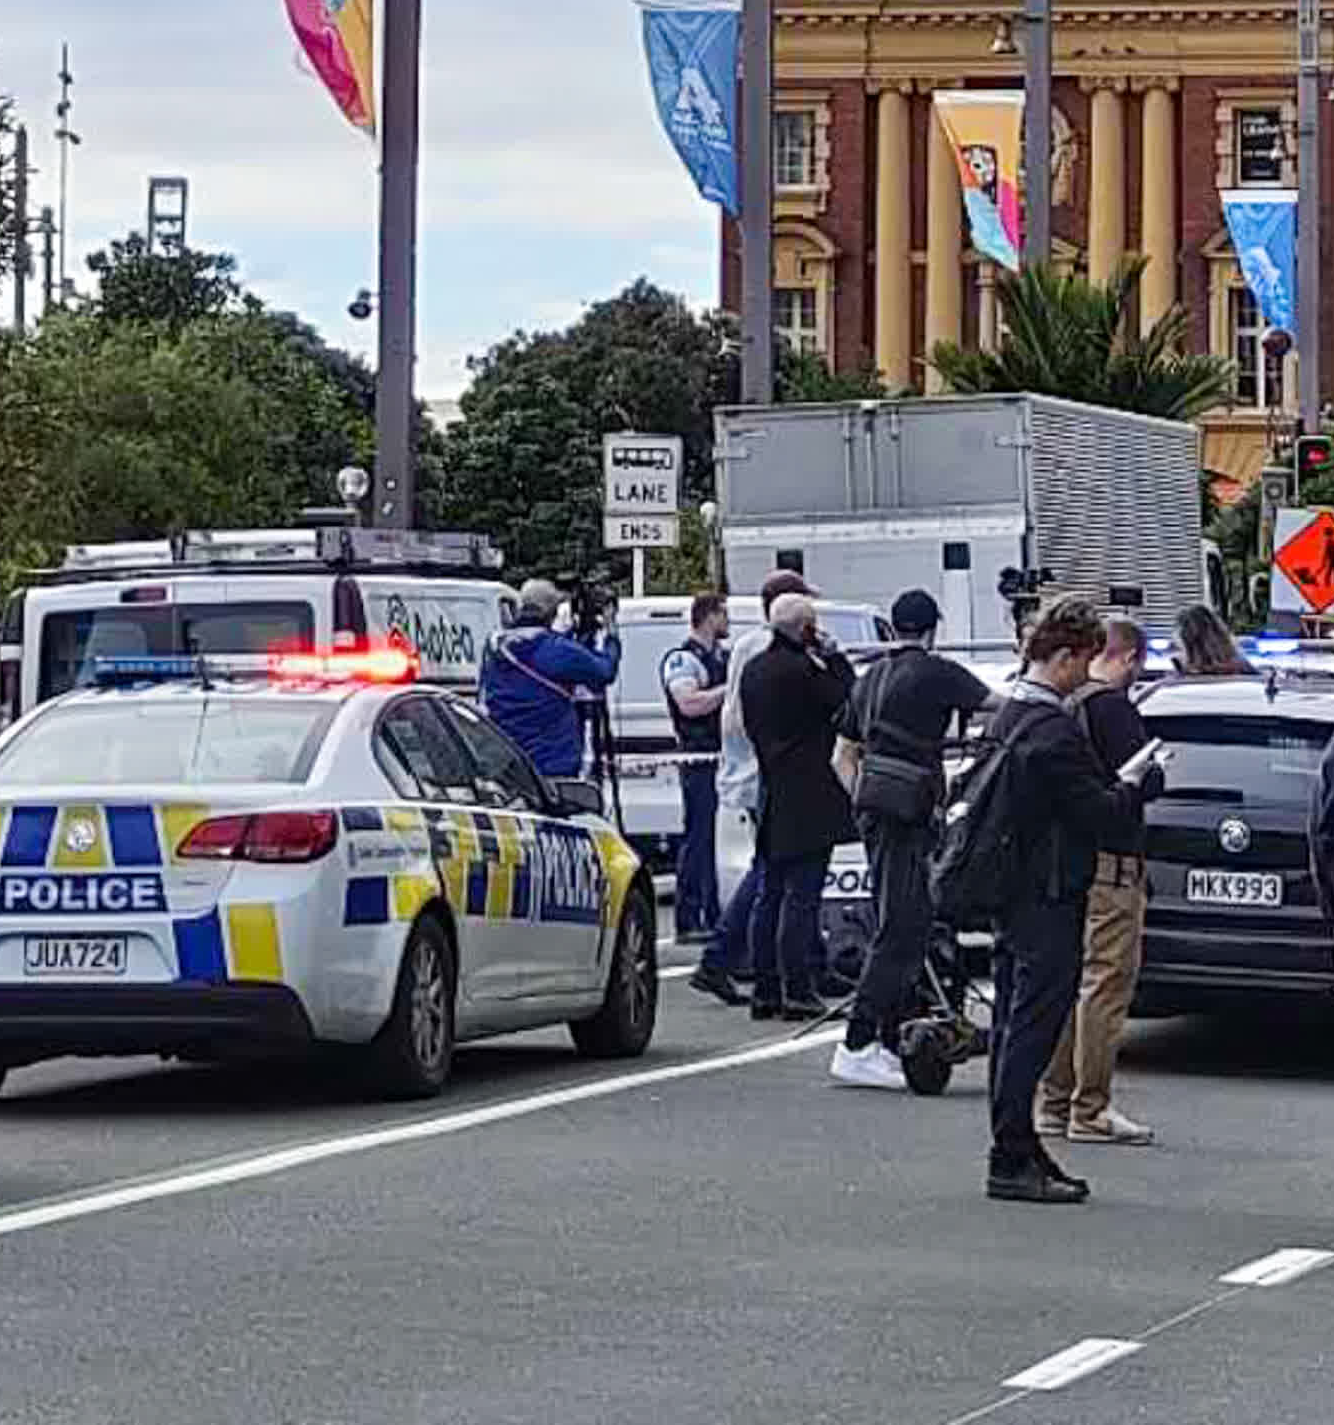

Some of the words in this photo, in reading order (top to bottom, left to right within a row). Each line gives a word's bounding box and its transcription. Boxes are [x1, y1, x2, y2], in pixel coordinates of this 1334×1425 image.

[613, 483, 668, 503] LANE
[620, 524, 662, 540] ENDS
[3, 878, 158, 910] POLICE
[29, 941, 121, 968] JUA724
